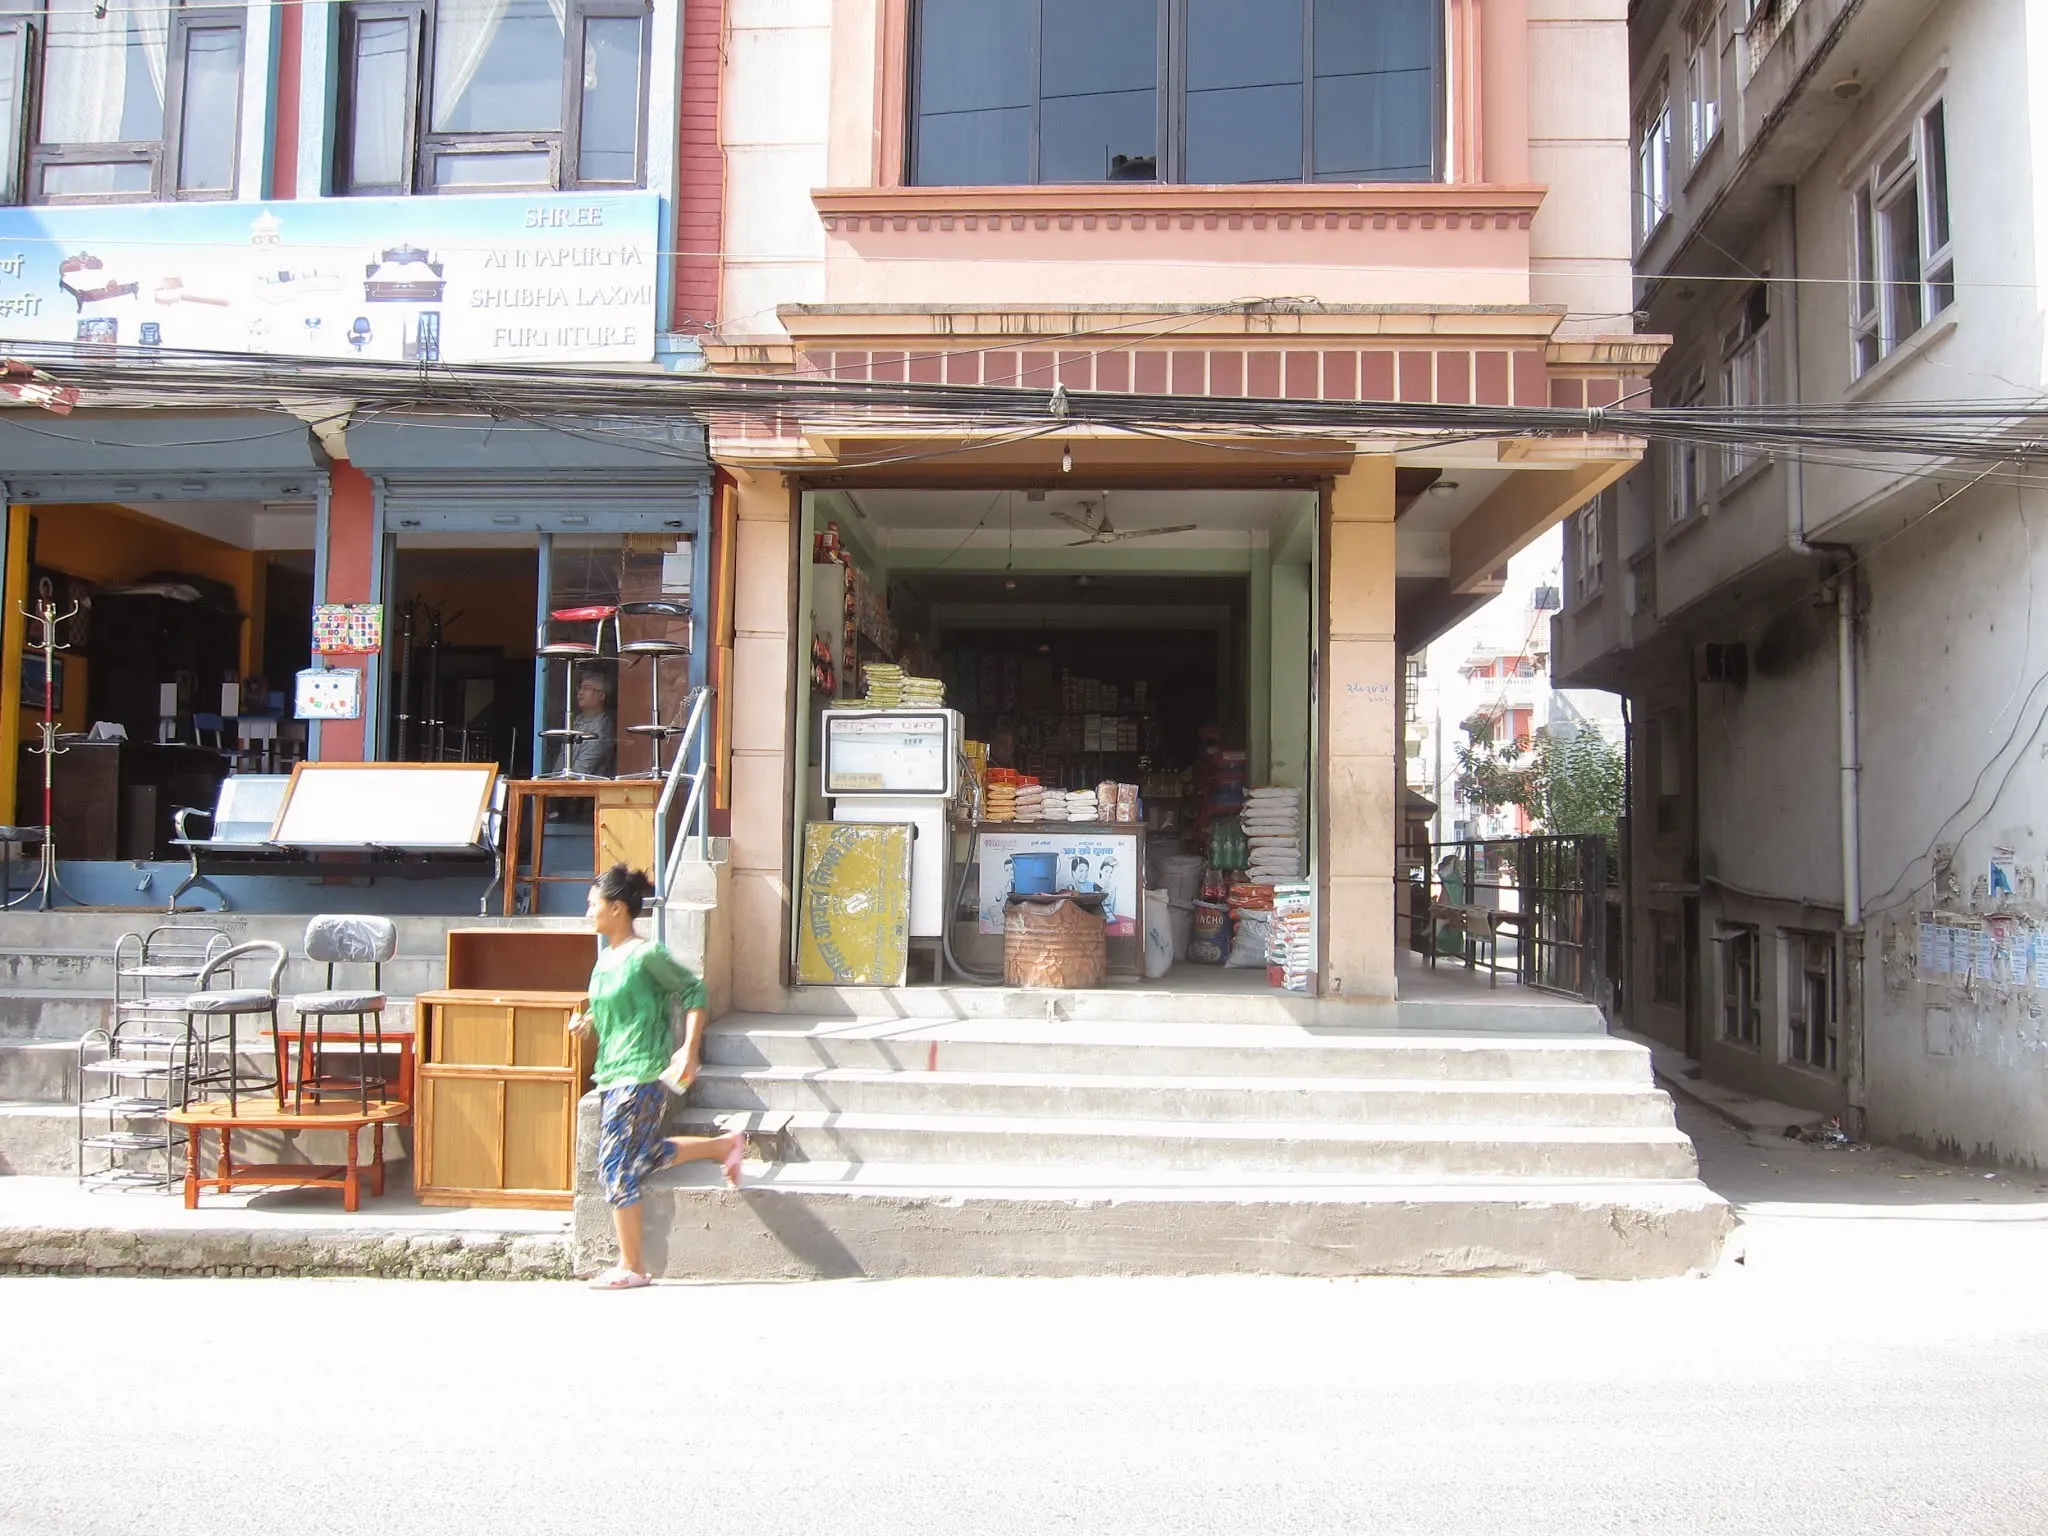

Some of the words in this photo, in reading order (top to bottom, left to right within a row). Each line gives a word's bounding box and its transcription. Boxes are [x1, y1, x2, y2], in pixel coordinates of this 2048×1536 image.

[524, 206, 604, 229] SHREE
[483, 244, 643, 269] ANNAPURNA
[470, 286, 569, 309] SHUBHA
[575, 283, 653, 307] LAXMI
[493, 325, 637, 348] FURNITURE
